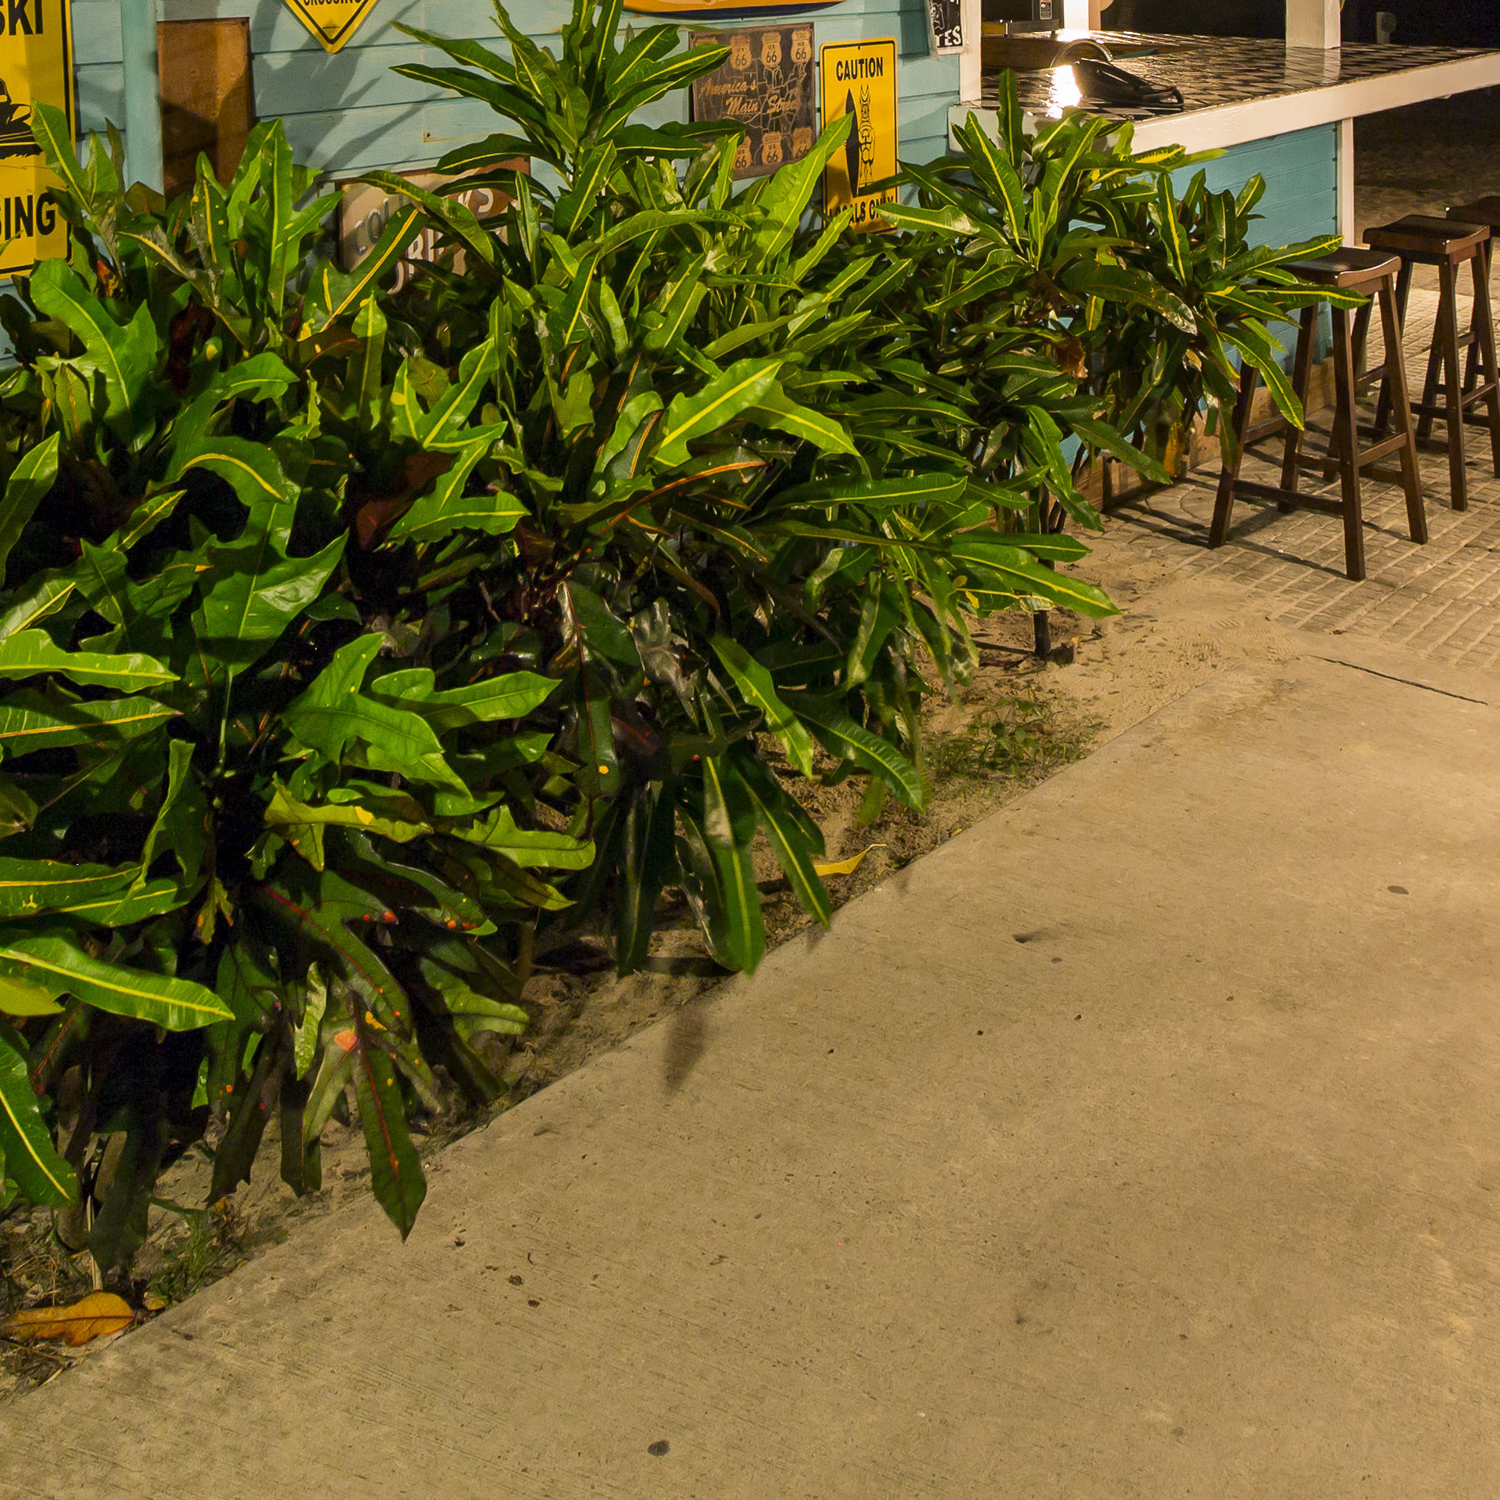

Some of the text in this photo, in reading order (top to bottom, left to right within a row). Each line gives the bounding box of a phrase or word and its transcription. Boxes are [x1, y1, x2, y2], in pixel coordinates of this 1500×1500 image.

[766, 51, 777, 63] 66
[796, 48, 807, 60] 66
[735, 55, 747, 67] 66
[836, 57, 883, 81] CAUTION
[726, 97, 758, 115] Main
[735, 156, 746, 168] 66
[767, 151, 778, 163] 66
